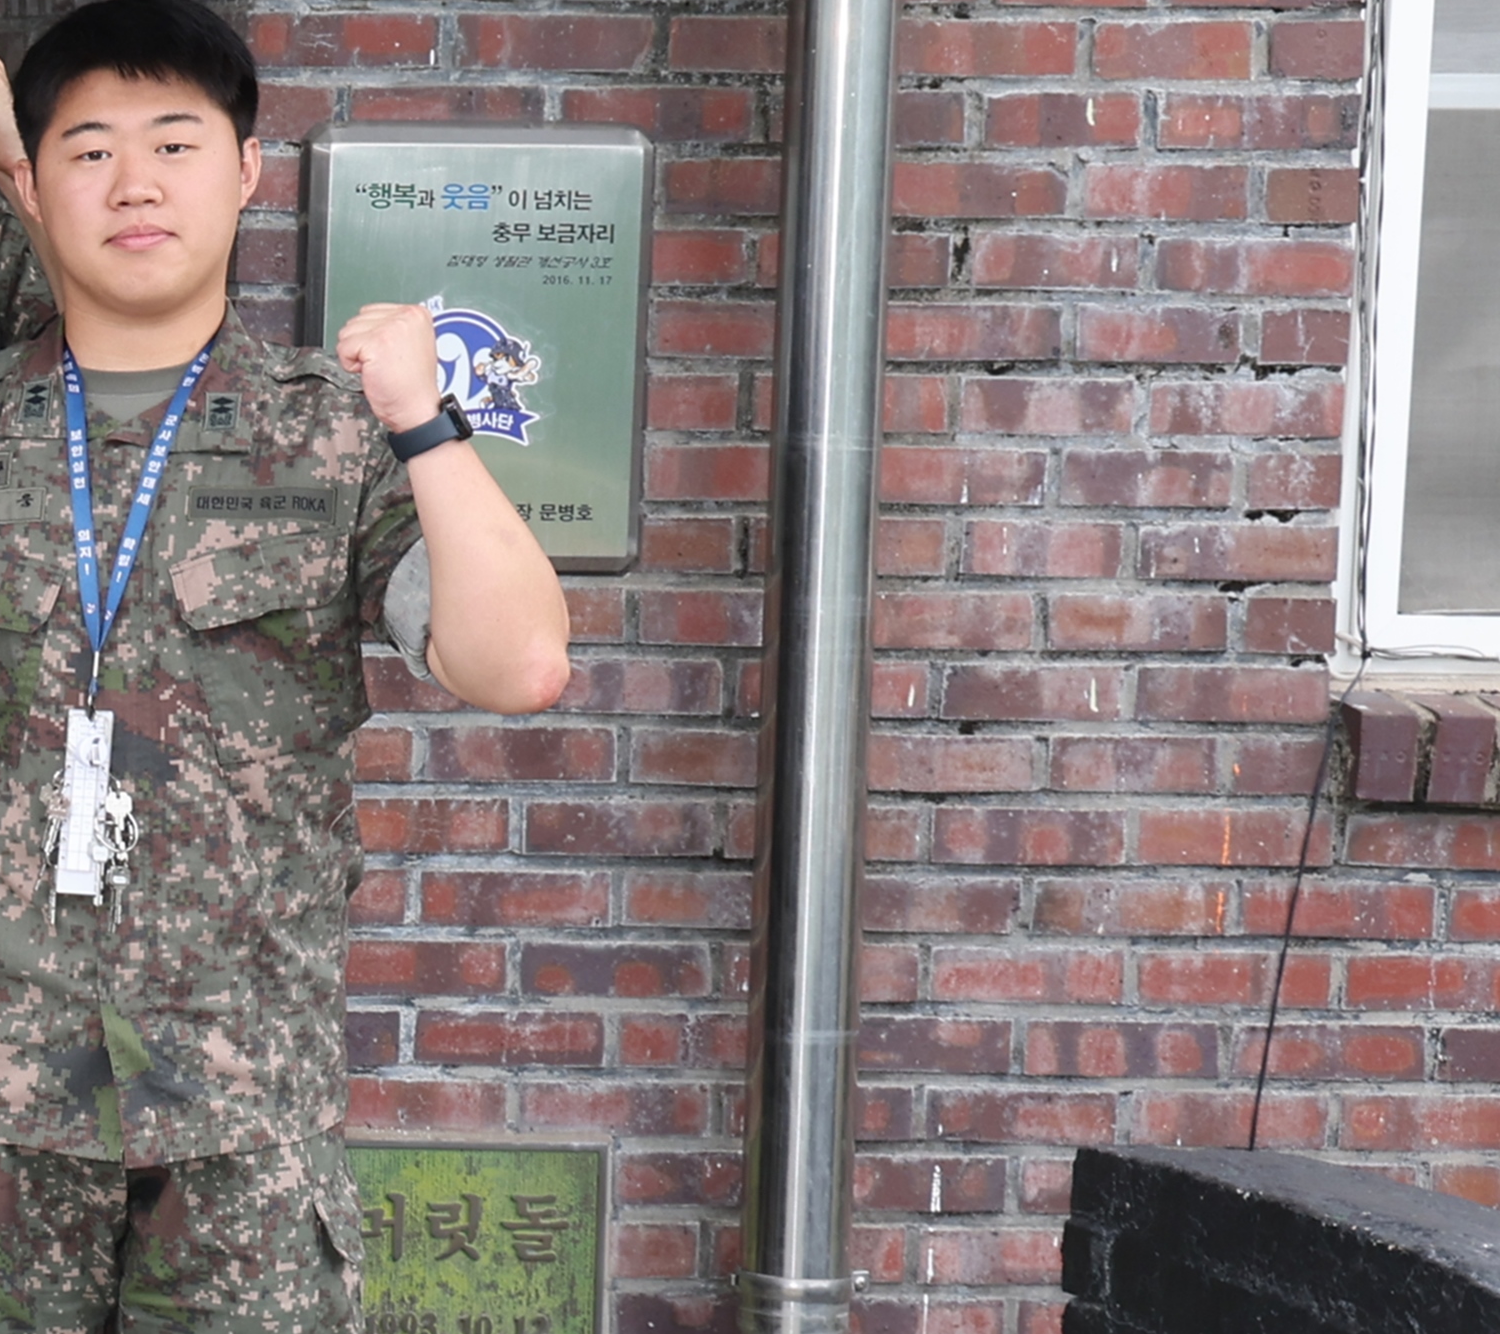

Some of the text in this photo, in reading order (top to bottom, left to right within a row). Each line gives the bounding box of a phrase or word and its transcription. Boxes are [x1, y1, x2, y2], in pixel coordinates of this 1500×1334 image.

[508, 189, 528, 210] 이
[533, 189, 593, 211] 넘치는
[492, 222, 616, 244] 충무 보금자리
[542, 275, 613, 285] 2016. 11. 17
[196, 495, 327, 513] 대한민국 육군 ROKA
[538, 503, 594, 522] 문병호
[362, 1192, 570, 1263] 머릿돌
